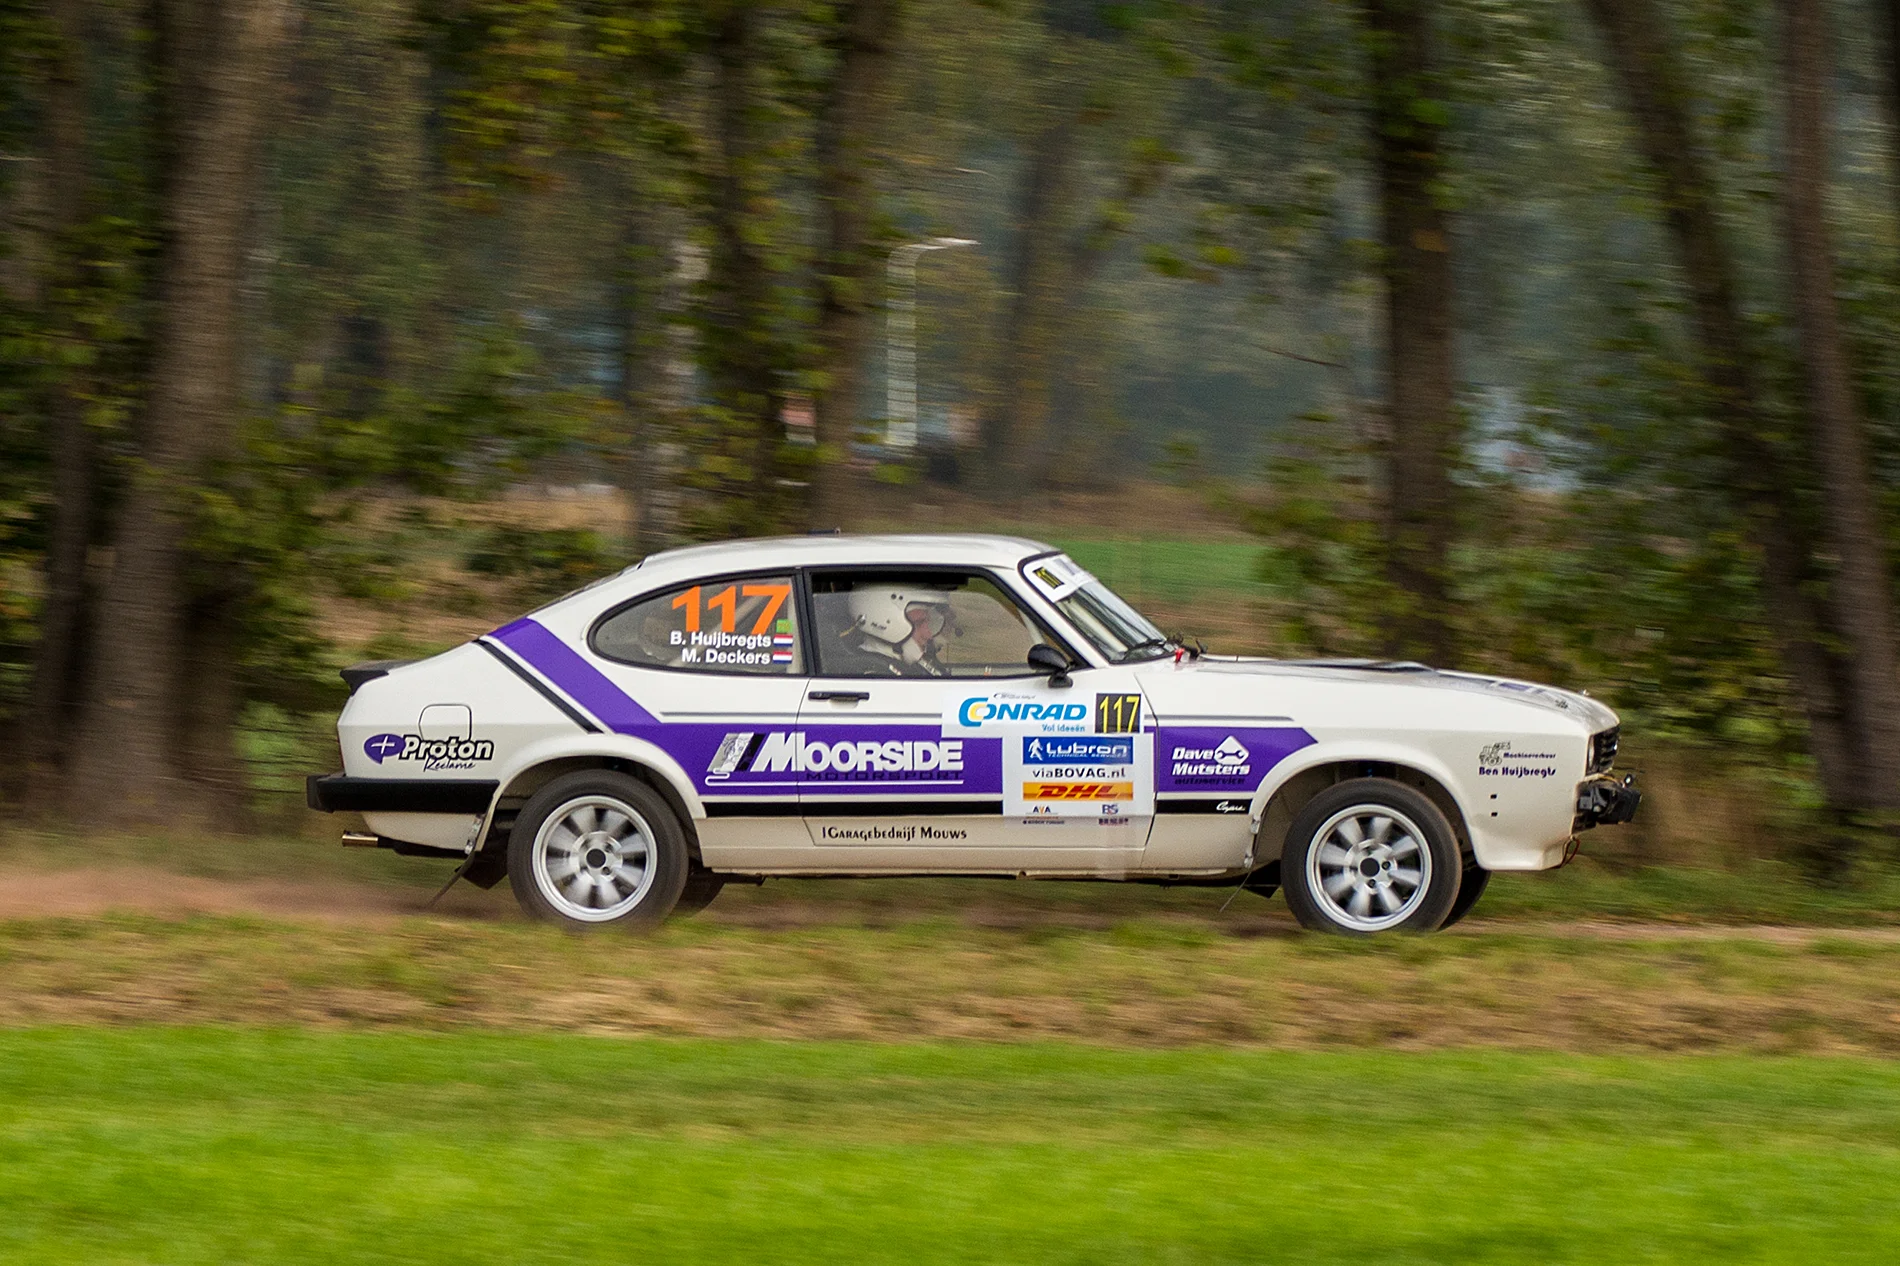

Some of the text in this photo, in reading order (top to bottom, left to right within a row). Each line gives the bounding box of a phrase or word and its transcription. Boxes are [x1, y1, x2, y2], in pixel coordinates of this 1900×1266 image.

[672, 585, 791, 635] 117
[670, 630, 771, 649] B. Huijbregts
[681, 648, 770, 664] M. Deckers
[958, 697, 1086, 727] CONRAD
[1099, 695, 1140, 733] 117
[399, 734, 494, 760] Proton
[750, 731, 964, 773] MOORSIDE
[1046, 742, 1127, 755] Lubron
[1172, 747, 1214, 760] Dave
[423, 755, 475, 772] Reclame
[1172, 763, 1250, 775] Mutsters
[805, 771, 963, 782] MOTORSPORT
[1033, 767, 1126, 779] viaBOVAG.nl
[1479, 766, 1556, 778] Ben Huijbregts
[1174, 776, 1245, 785] autoservice
[1037, 785, 1119, 799] DHL
